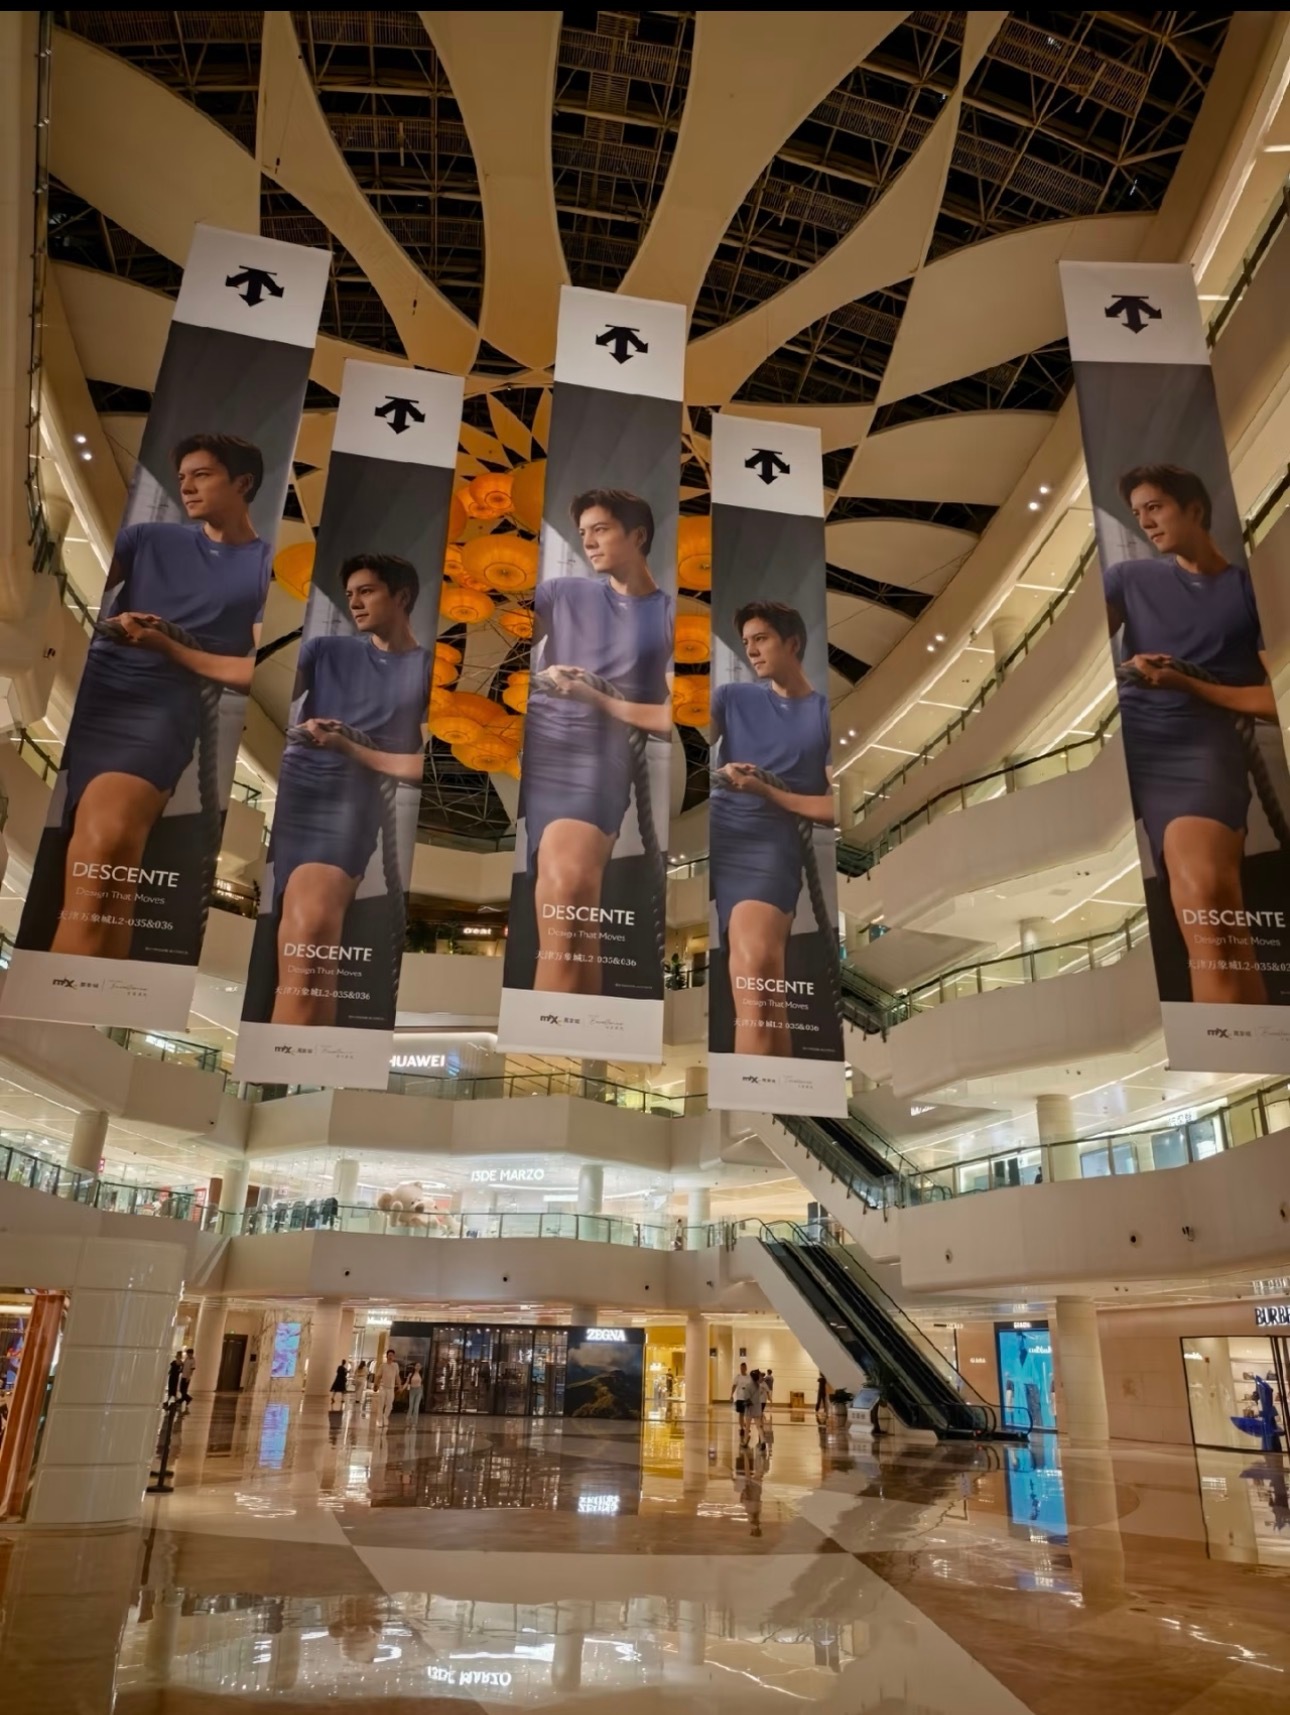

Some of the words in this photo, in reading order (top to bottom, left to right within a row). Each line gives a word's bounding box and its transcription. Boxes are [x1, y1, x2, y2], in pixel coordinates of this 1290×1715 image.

[72, 861, 180, 888] DESCENTE
[75, 886, 109, 899] Design
[111, 889, 132, 901] That
[134, 893, 166, 905] Moves
[542, 903, 636, 926] DESCENTE
[1182, 909, 1286, 928] DESCENTE
[547, 928, 577, 939] Design
[578, 930, 597, 939] That
[598, 932, 626, 942] Moves
[1193, 934, 1226, 946] Design
[1228, 935, 1249, 945] That
[1250, 936, 1282, 947] Moves
[283, 943, 373, 962] DESCENTE
[287, 965, 316, 975] Design
[317, 966, 334, 976] That
[336, 968, 362, 978] Moves
[735, 976, 815, 995] DESCENTE
[742, 998, 767, 1008] Design
[768, 999, 785, 1009] That
[785, 1001, 809, 1010] Moves
[389, 1054, 446, 1068] HUAWEI
[499, 1168, 545, 1181] MARZO
[586, 1327, 627, 1342] ZEGNA
